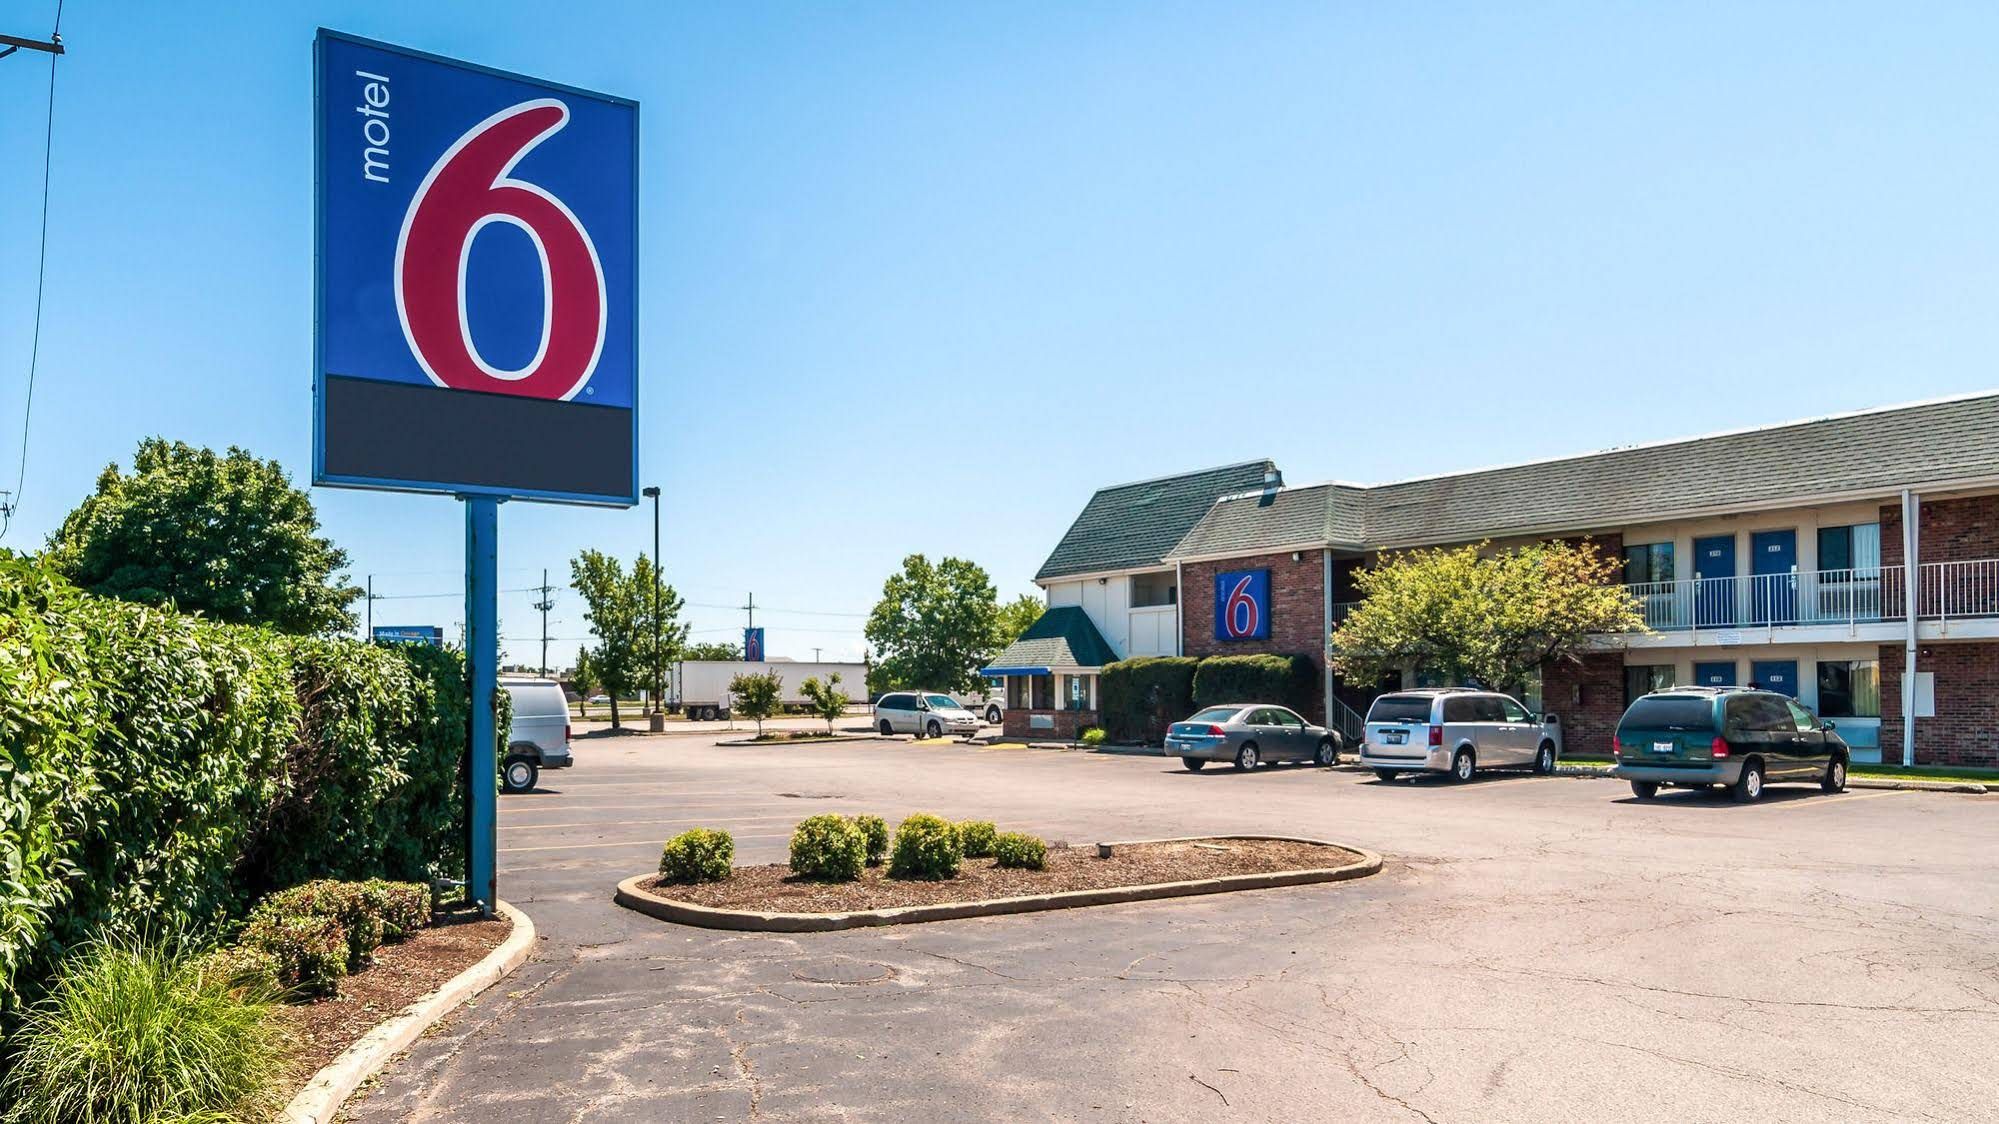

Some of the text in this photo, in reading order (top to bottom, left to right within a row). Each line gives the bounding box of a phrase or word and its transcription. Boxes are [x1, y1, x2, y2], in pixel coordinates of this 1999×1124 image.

[356, 70, 390, 183] motel
[394, 98, 608, 402] 6
[748, 630, 760, 661] 6
[1225, 575, 1258, 638] 6
